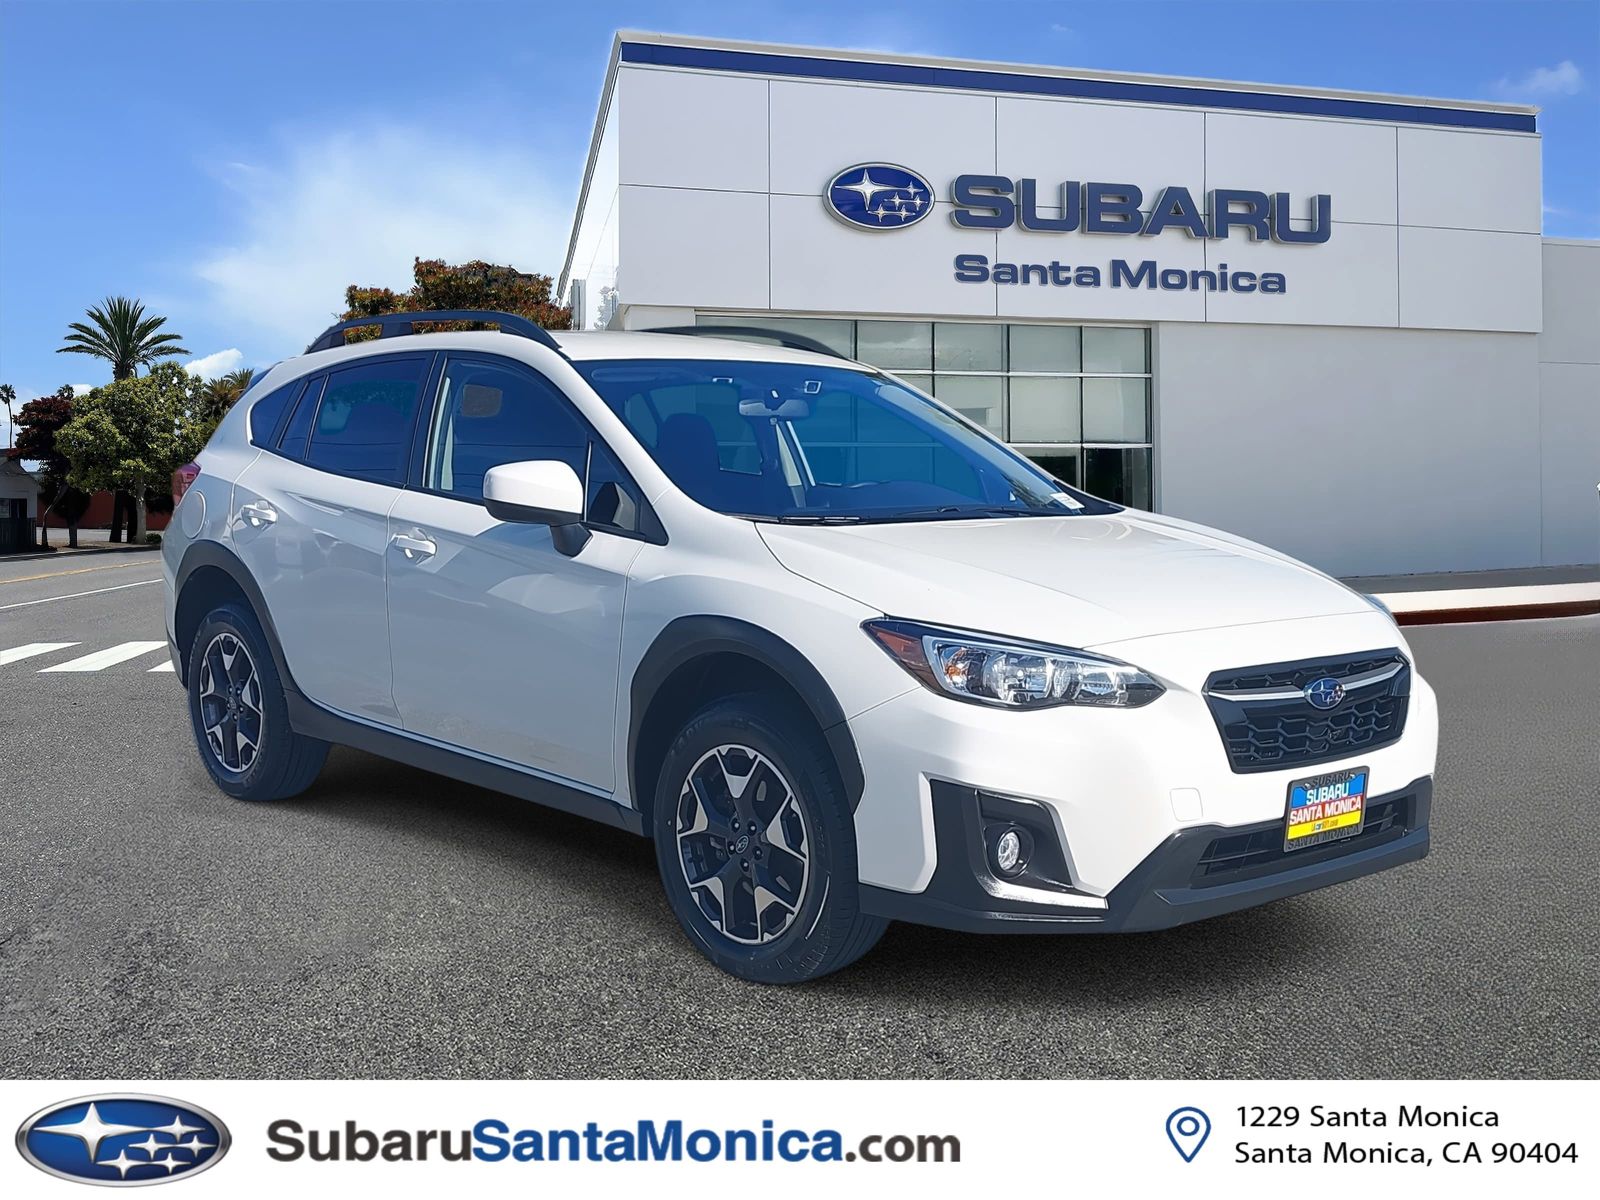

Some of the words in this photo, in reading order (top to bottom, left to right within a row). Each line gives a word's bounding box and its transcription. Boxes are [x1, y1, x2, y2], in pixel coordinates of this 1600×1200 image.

[950, 174, 1332, 244] SUBARU
[953, 253, 1102, 288] Santa
[1110, 258, 1287, 295] Monica
[1306, 782, 1350, 805] SUBARU
[1312, 771, 1351, 786] SUBARU
[1289, 804, 1323, 826] SANTA
[1324, 796, 1362, 818] MONICA
